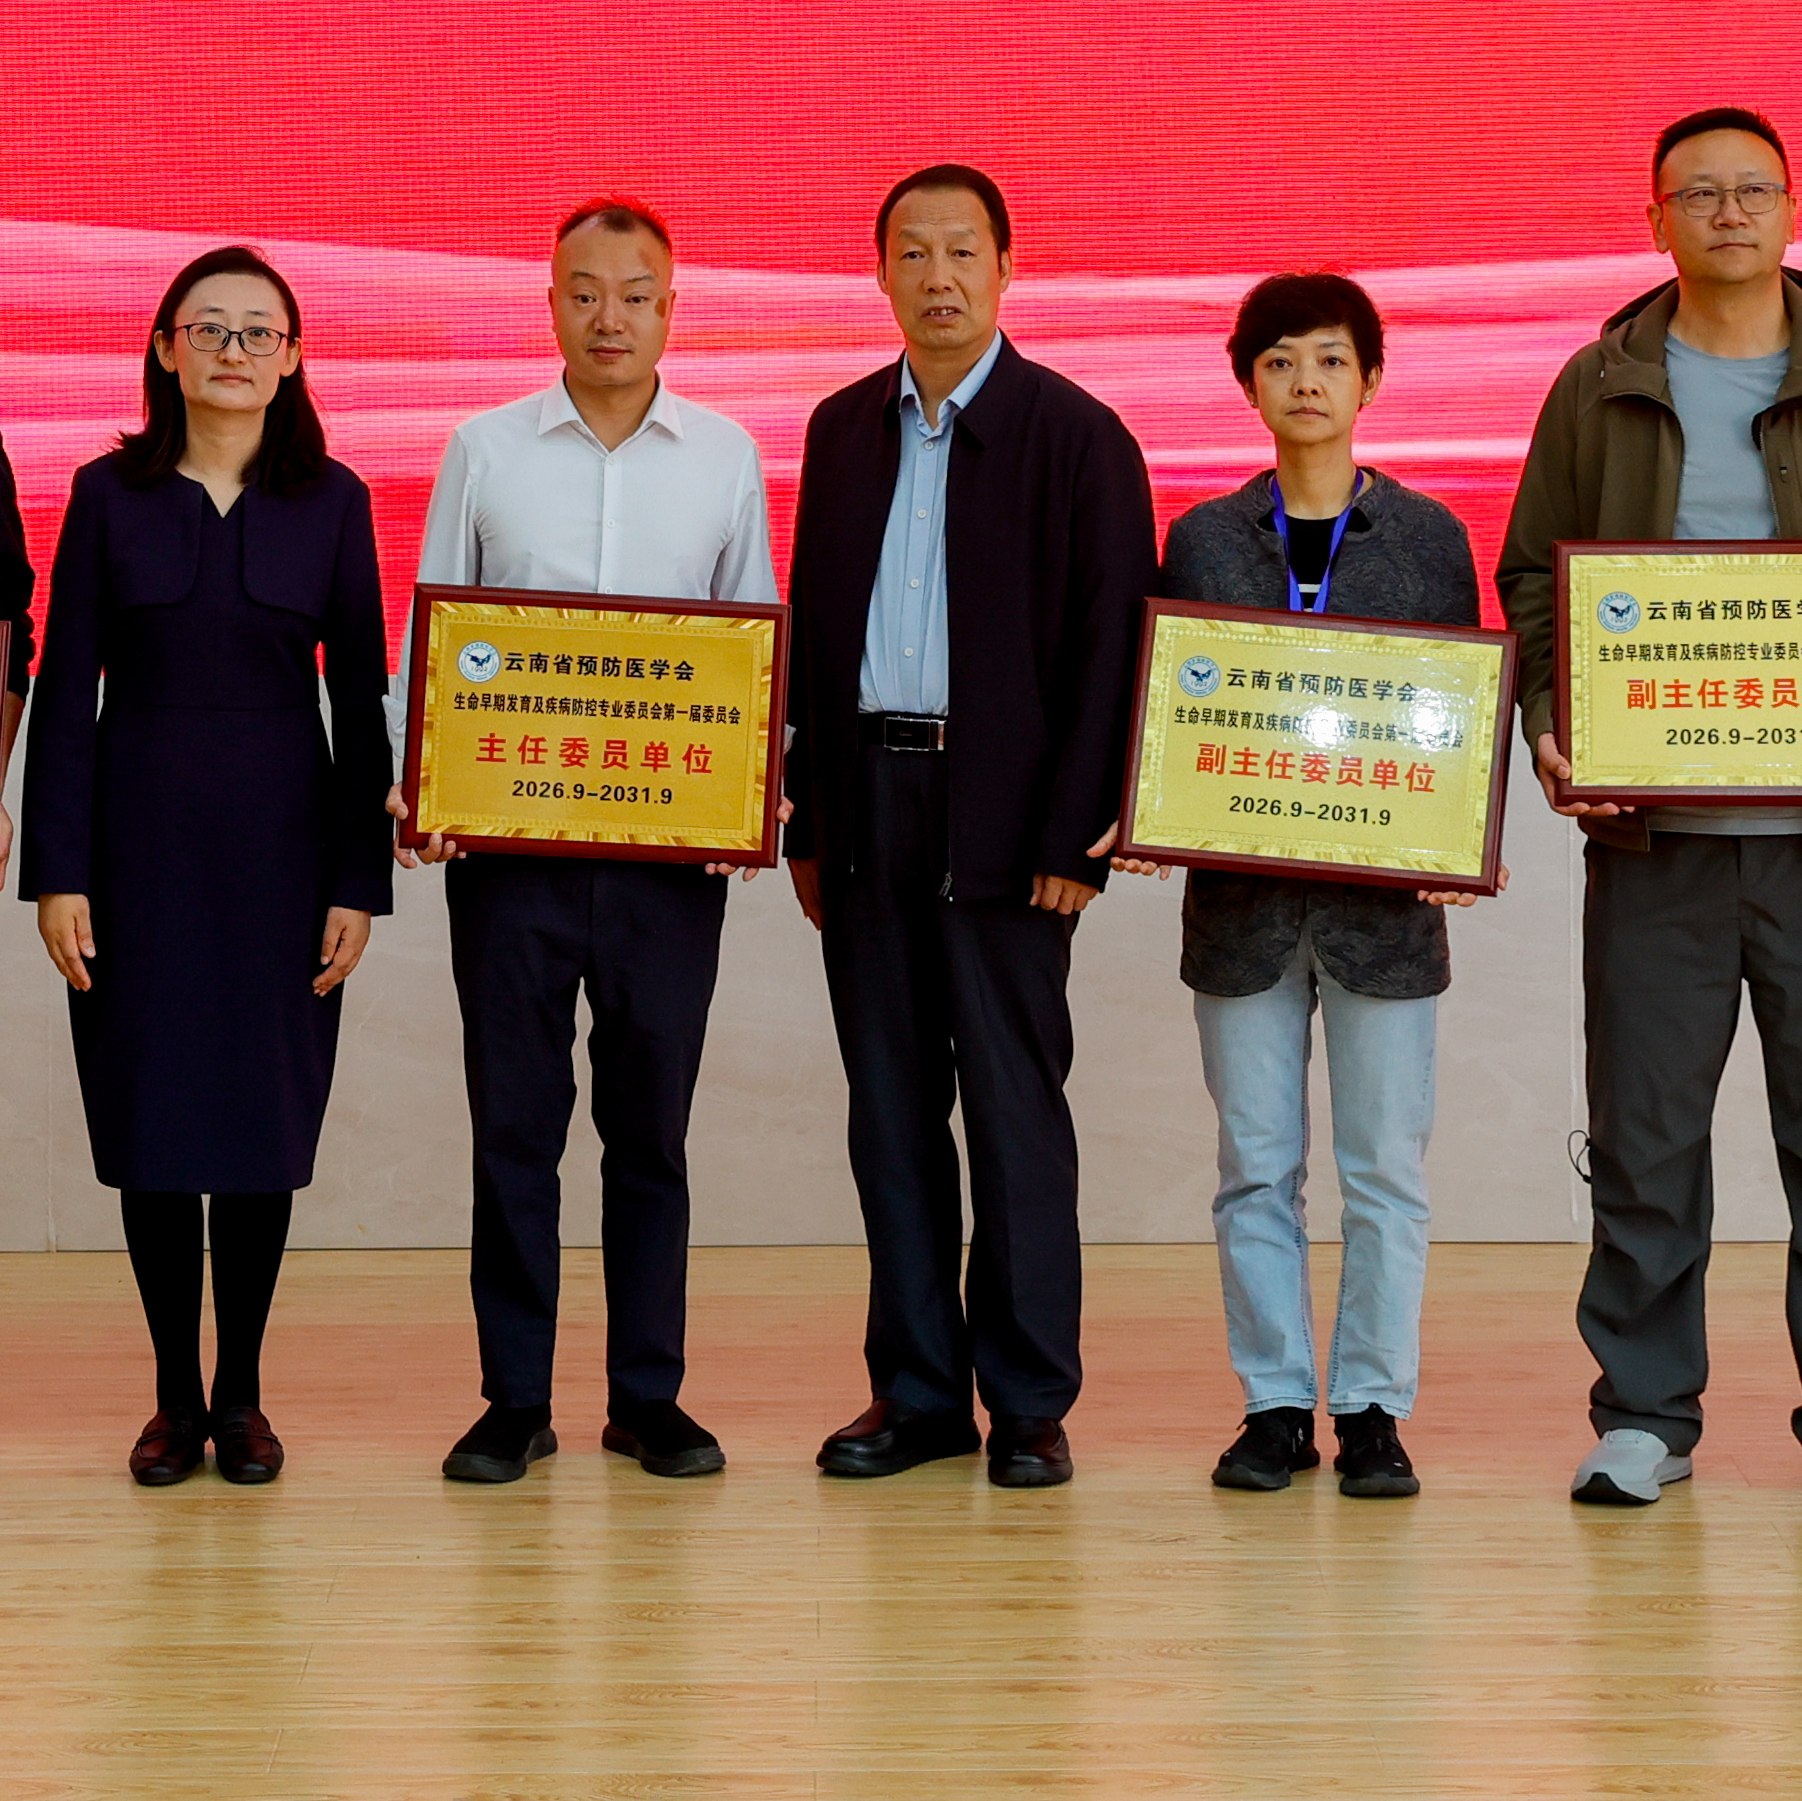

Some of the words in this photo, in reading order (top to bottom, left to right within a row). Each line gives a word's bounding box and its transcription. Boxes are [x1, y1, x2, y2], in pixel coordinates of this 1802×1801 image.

[504, 652, 695, 682] 云南省预防医学会
[1226, 667, 1417, 702] 云南省预防医学会
[453, 691, 741, 725] 生命早期发育及疾病防控专业委员会第一届委员会
[475, 732, 713, 775] 主任委员单位
[1196, 742, 1436, 793] 副主任委员单位
[512, 779, 673, 805] 2026.9-2031.9
[1229, 795, 1391, 826] 2026.9-2031.9
